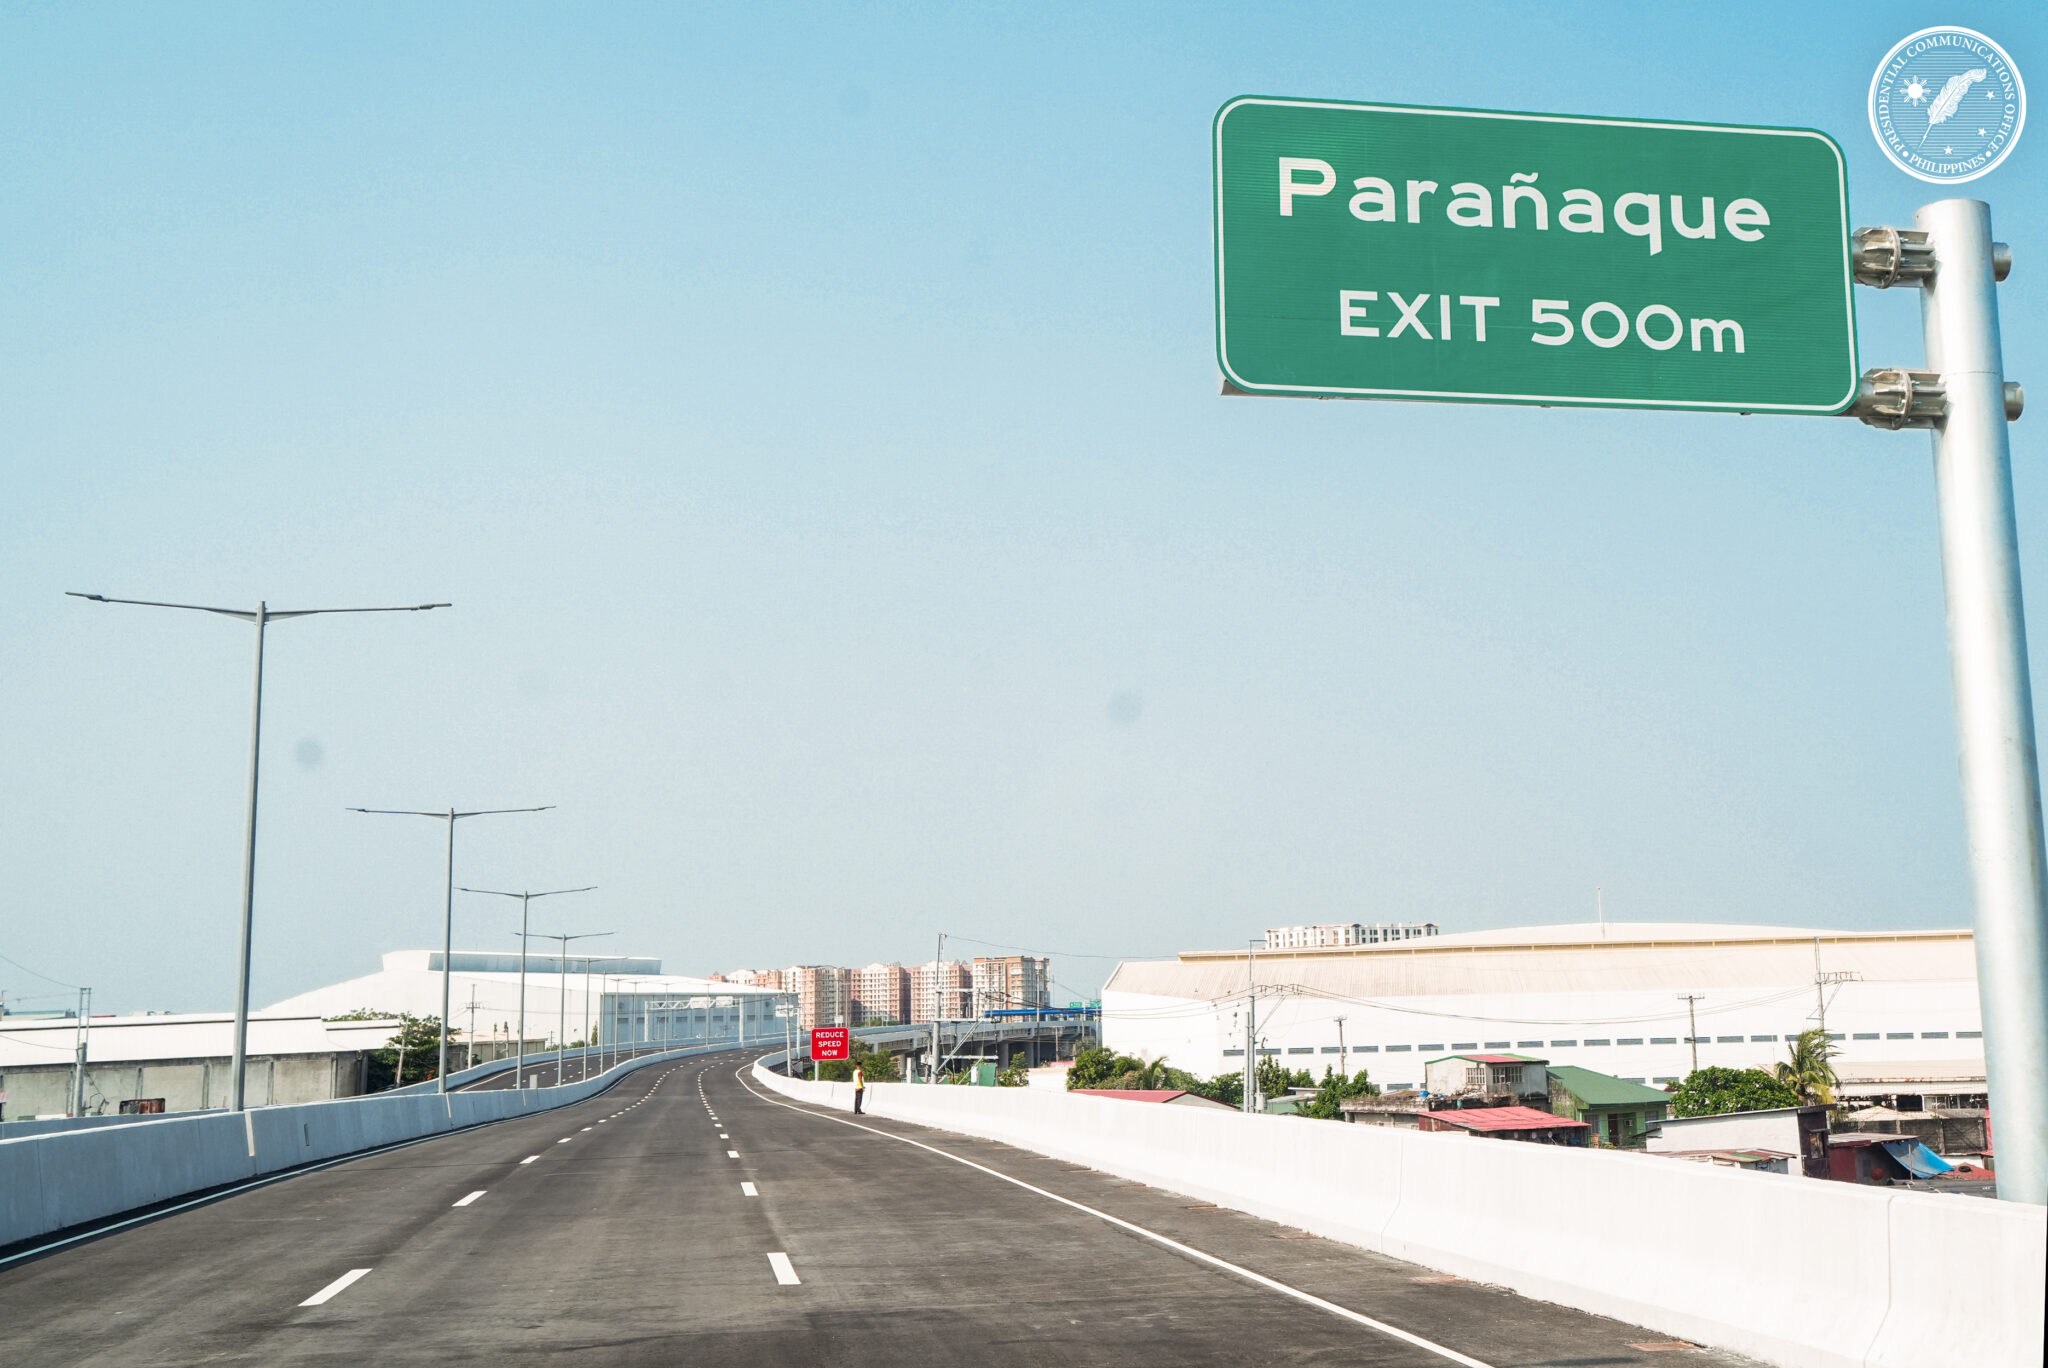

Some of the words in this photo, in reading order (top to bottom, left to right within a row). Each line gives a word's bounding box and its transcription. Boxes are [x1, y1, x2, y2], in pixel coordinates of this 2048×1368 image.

[1278, 157, 1770, 256] Parañaque
[1340, 290, 1500, 342] EXIT
[1531, 299, 1745, 354] 500m
